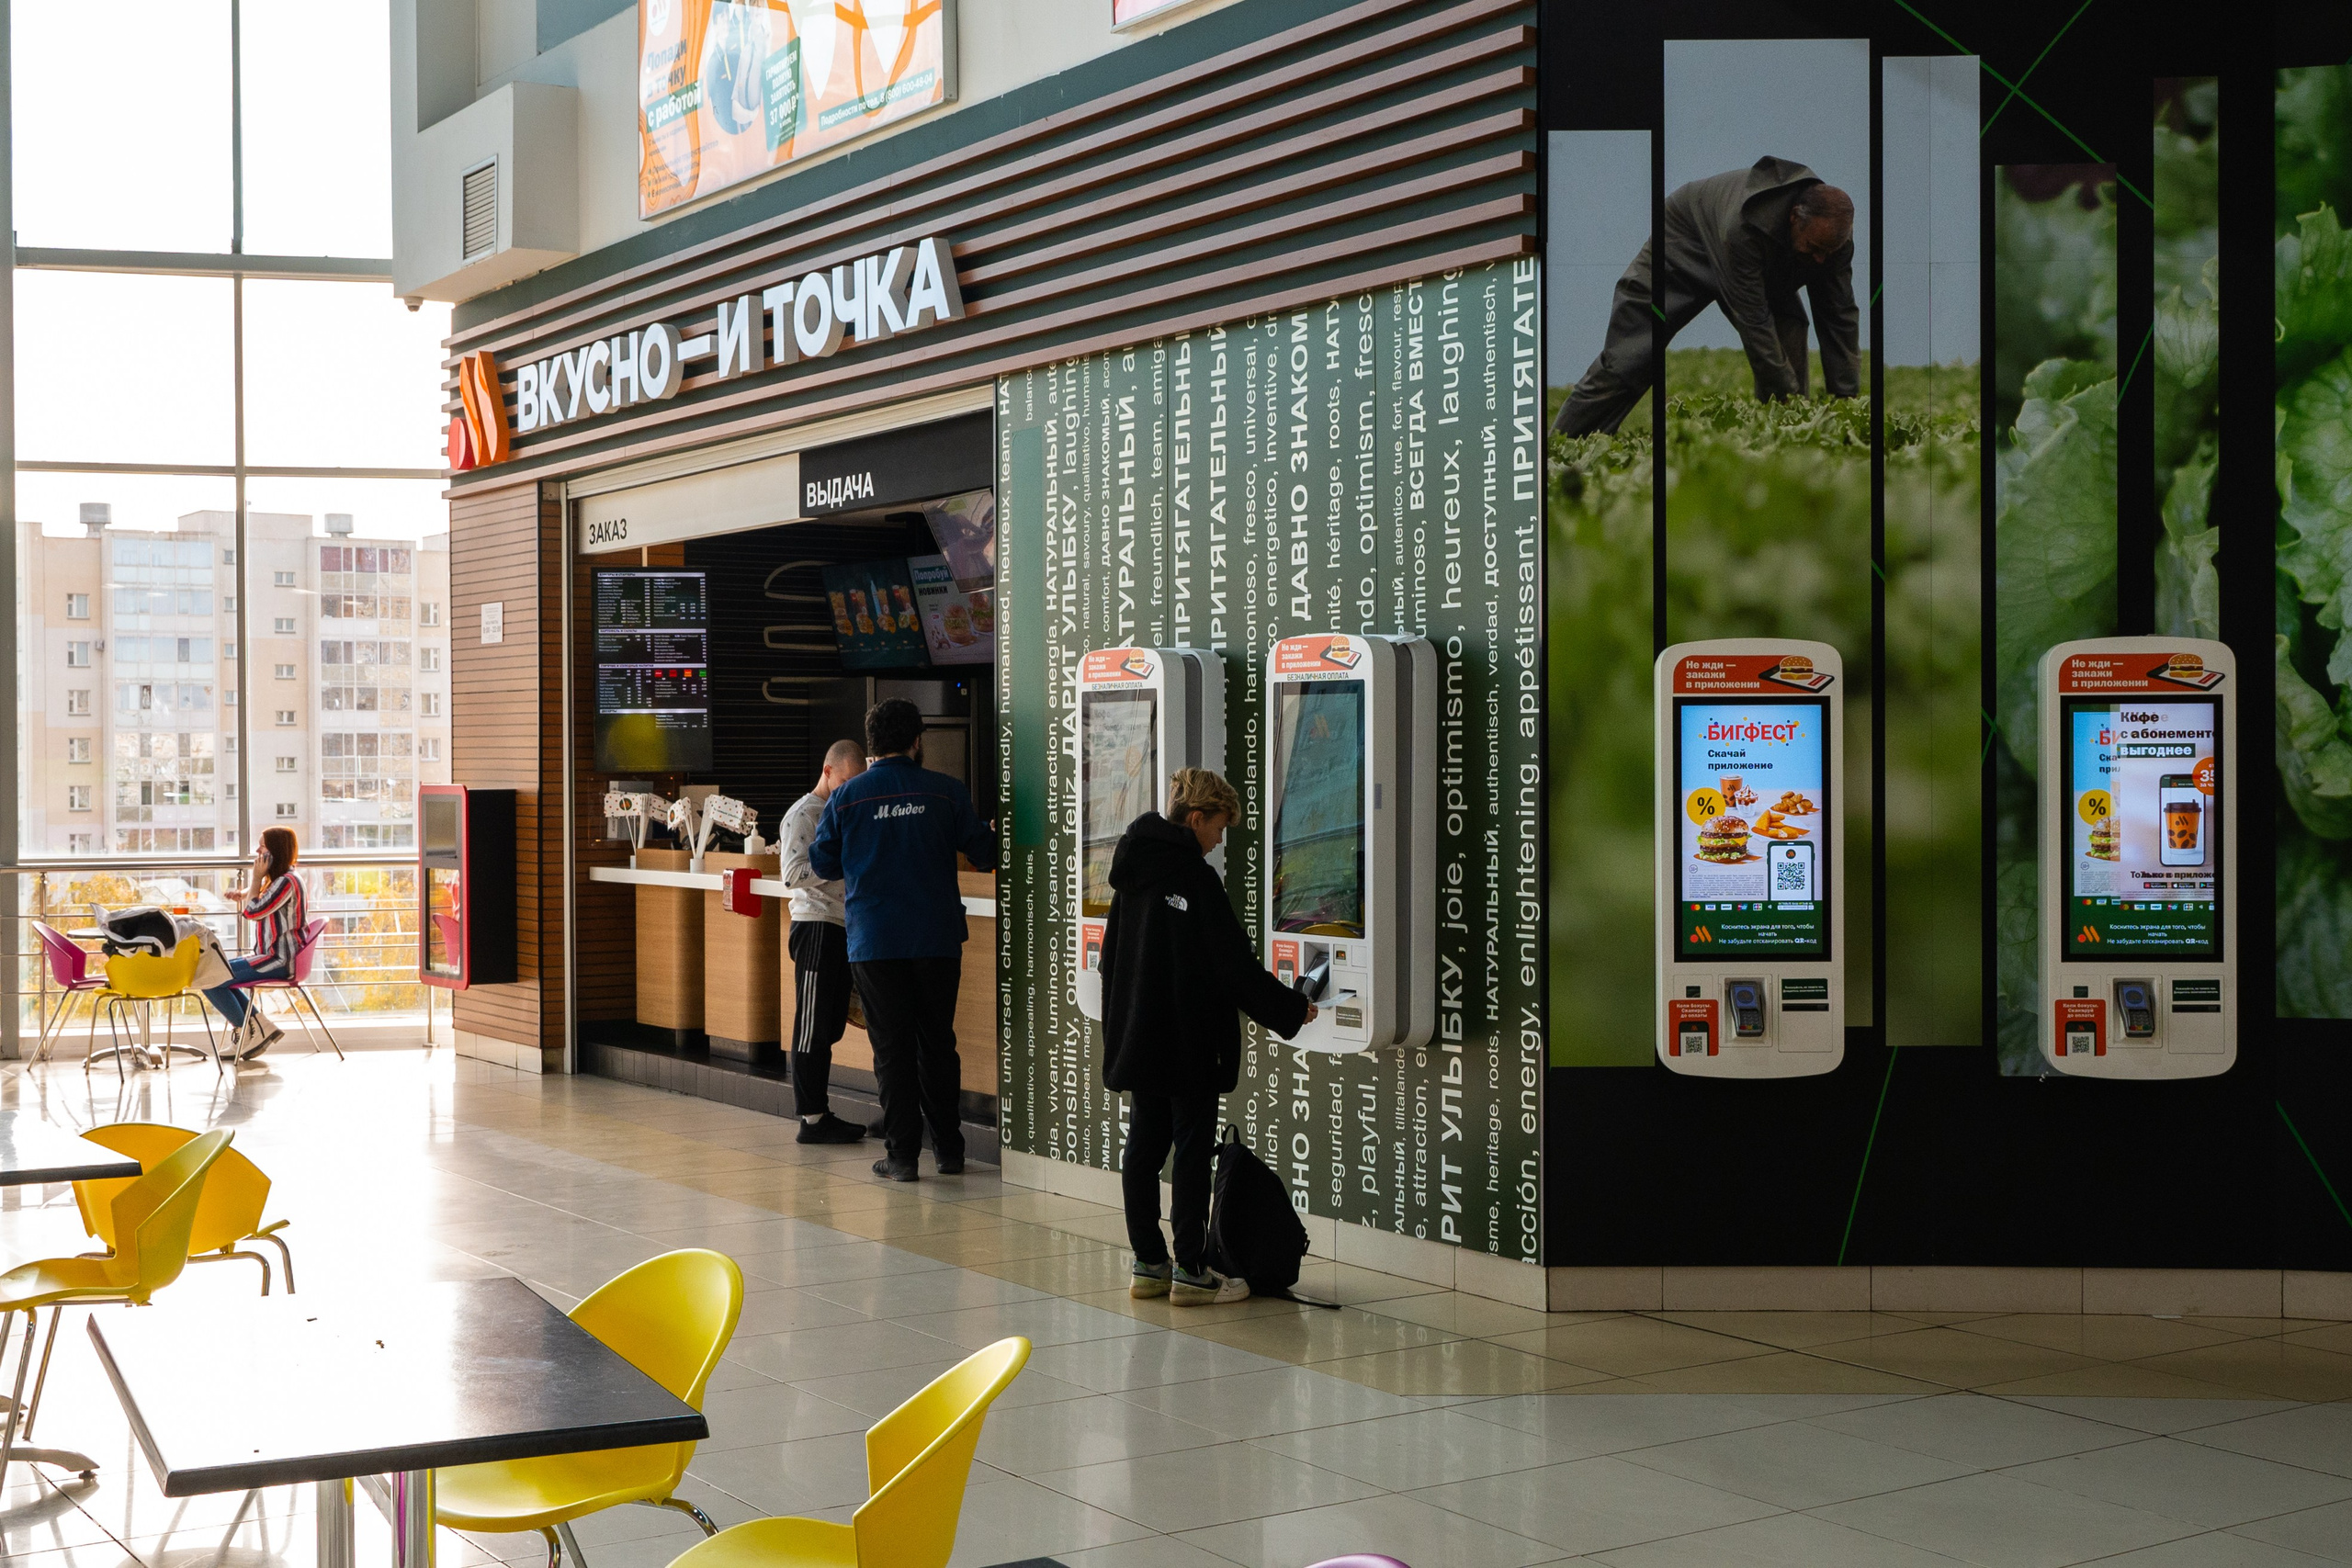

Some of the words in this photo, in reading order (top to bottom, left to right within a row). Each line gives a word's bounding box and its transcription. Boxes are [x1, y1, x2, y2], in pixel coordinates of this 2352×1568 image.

[647, 39, 687, 71] Попади
[656, 64, 686, 93] точку
[648, 113, 654, 127] с
[656, 83, 702, 128] работой
[770, 107, 778, 126] 37
[820, 105, 858, 126] Подробности
[858, 102, 866, 111] по
[880, 93, 885, 103] 8
[885, 85, 901, 103] (800)
[901, 73, 933, 95] 600-48-04
[517, 322, 673, 432] ВКУСНО
[718, 296, 752, 378] И
[763, 237, 952, 365] ТОЧКА
[1483, 278, 1497, 410] authentisch,
[1409, 389, 1426, 510] ВСЕГДА
[806, 471, 875, 509] ВЫДАЧА
[1481, 419, 1498, 587] ДОСТУПНЫЙ,
[588, 517, 628, 546] ЗАКАЗ
[1102, 505, 1111, 567] ДАВНО
[1442, 440, 1463, 608] heureux,
[1291, 485, 1311, 621] ДАВНО
[1486, 595, 1498, 675] verdad,
[1516, 515, 1539, 738] appétissant,
[1287, 673, 1326, 682] БЕЗНАЛИЧНАЯ
[1686, 660, 1700, 669] Не
[1702, 660, 1724, 671] жди
[1686, 671, 1725, 679] закажи
[1694, 681, 1759, 690] приложении
[2072, 660, 2086, 668] Не
[2088, 660, 2110, 669] жди
[2072, 670, 2112, 678] закажи
[2081, 680, 2148, 689] приложении
[1063, 645, 1078, 759] ДАРИТ
[1442, 626, 1467, 835] optimismo,
[1487, 684, 1499, 815] authentisch,
[1708, 722, 1797, 742] БИГФЕСТ
[1708, 749, 1746, 758] Скачай
[2120, 746, 2192, 757] выгоднее
[1708, 761, 1773, 771] приложение
[873, 802, 925, 820] М.видео
[1442, 853, 1467, 933] joie,
[1516, 754, 1540, 986] enlightening,
[1485, 824, 1500, 1020] НАТУРАЛЬНЫЙ,
[1442, 947, 1465, 1141] УЛЫБКУ,
[1487, 1031, 1500, 1089] roots,
[1521, 1003, 1540, 1134] energy,
[1487, 1099, 1501, 1191] heritage,
